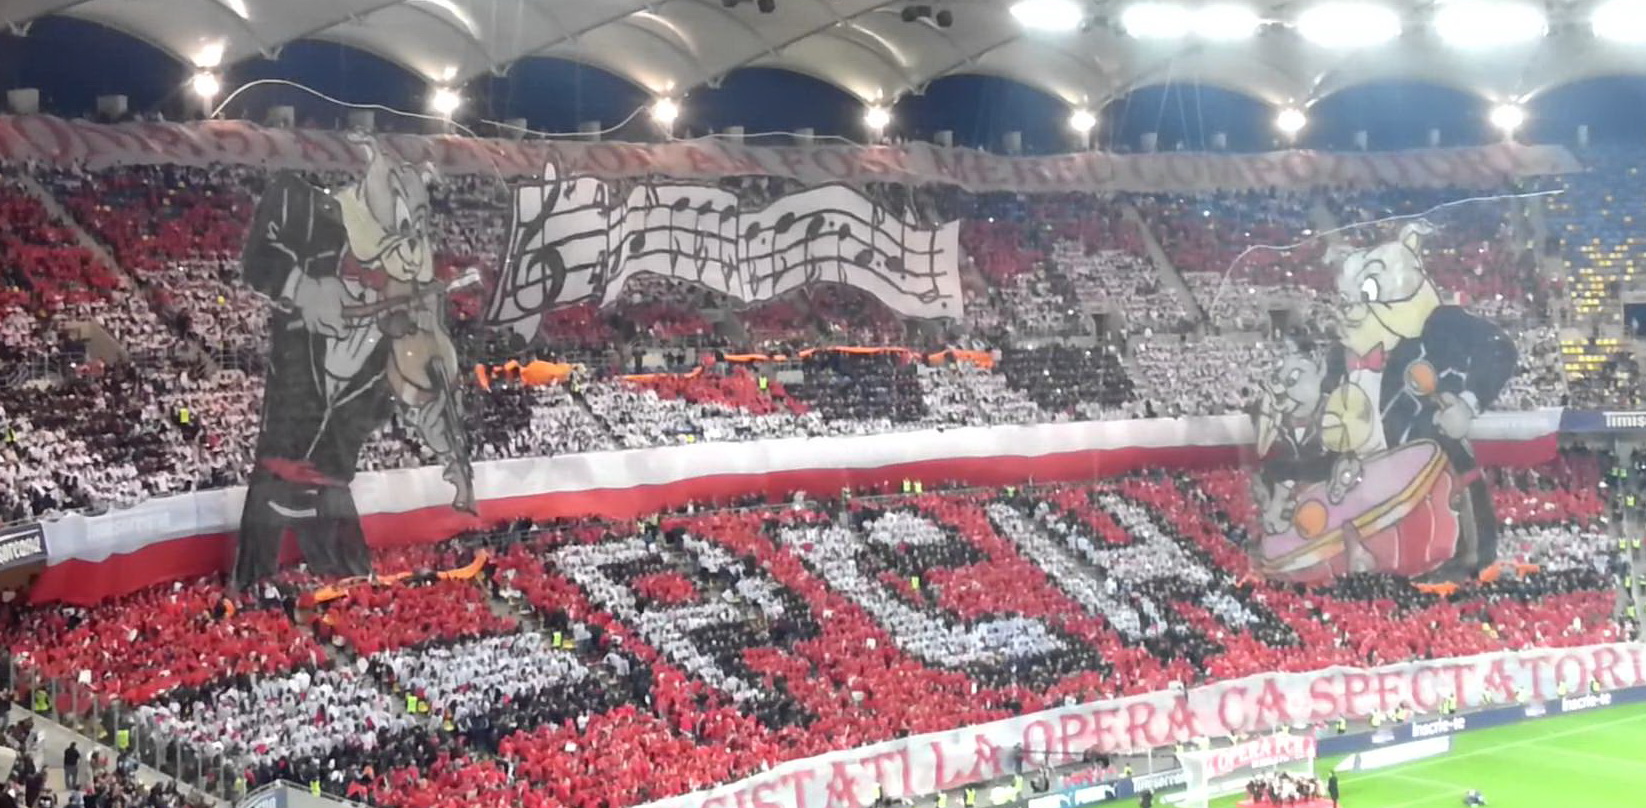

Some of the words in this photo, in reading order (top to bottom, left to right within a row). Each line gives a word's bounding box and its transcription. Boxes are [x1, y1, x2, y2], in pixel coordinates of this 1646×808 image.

[930, 734, 1006, 789] LA
[1022, 695, 1202, 769] OPERA
[1218, 677, 1294, 738] CA
